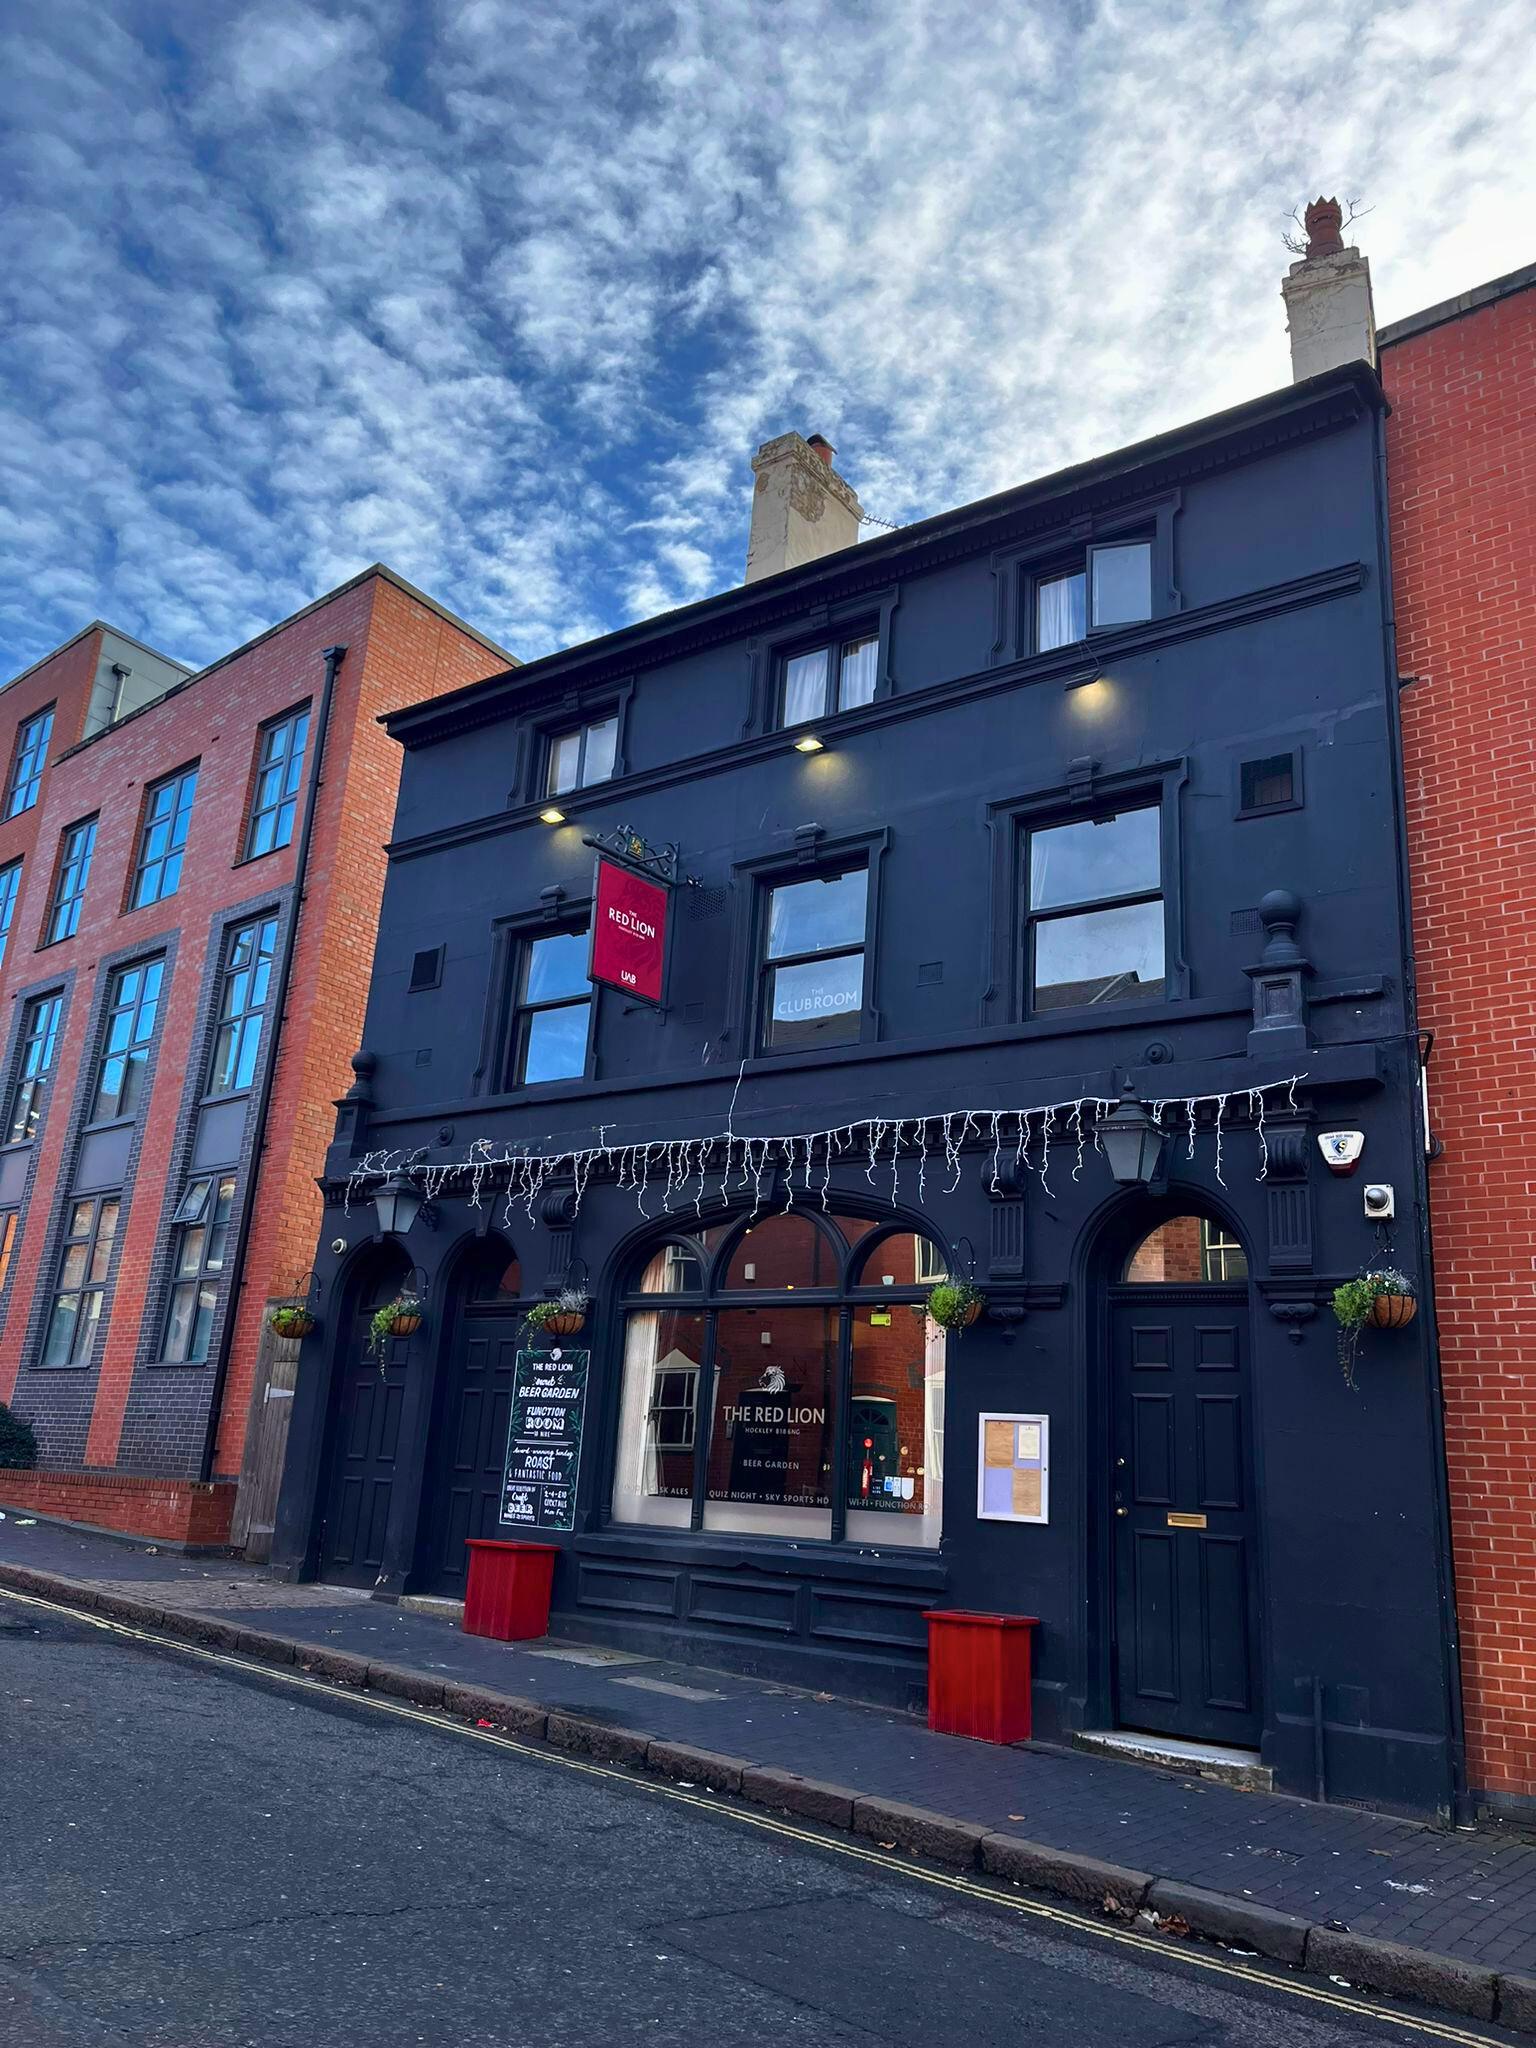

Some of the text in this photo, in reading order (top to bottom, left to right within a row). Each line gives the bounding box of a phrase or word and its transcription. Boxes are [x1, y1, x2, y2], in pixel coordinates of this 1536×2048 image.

[608, 907, 629, 926] RED
[631, 918, 655, 939] LION
[811, 988, 824, 996] THE
[532, 1363, 574, 1371] THE RED LION
[519, 1386, 580, 1399] BEER GARDEN
[526, 1406, 566, 1417] FUNCTION
[722, 1406, 825, 1425] THE RED LION
[525, 1416, 565, 1430] ROOM
[525, 1455, 555, 1470] ROAST
[743, 1459, 800, 1470] BEER GARDEN
[514, 1468, 546, 1480] FANTASTIC
[547, 1471, 562, 1481] FOOD
[670, 1487, 689, 1496] ALES
[709, 1489, 756, 1500] QUIZ NIGHT
[765, 1493, 829, 1505] SKY SPORTS HD
[848, 1498, 868, 1507] WI-FI
[874, 1500, 916, 1510] FUNCTION
